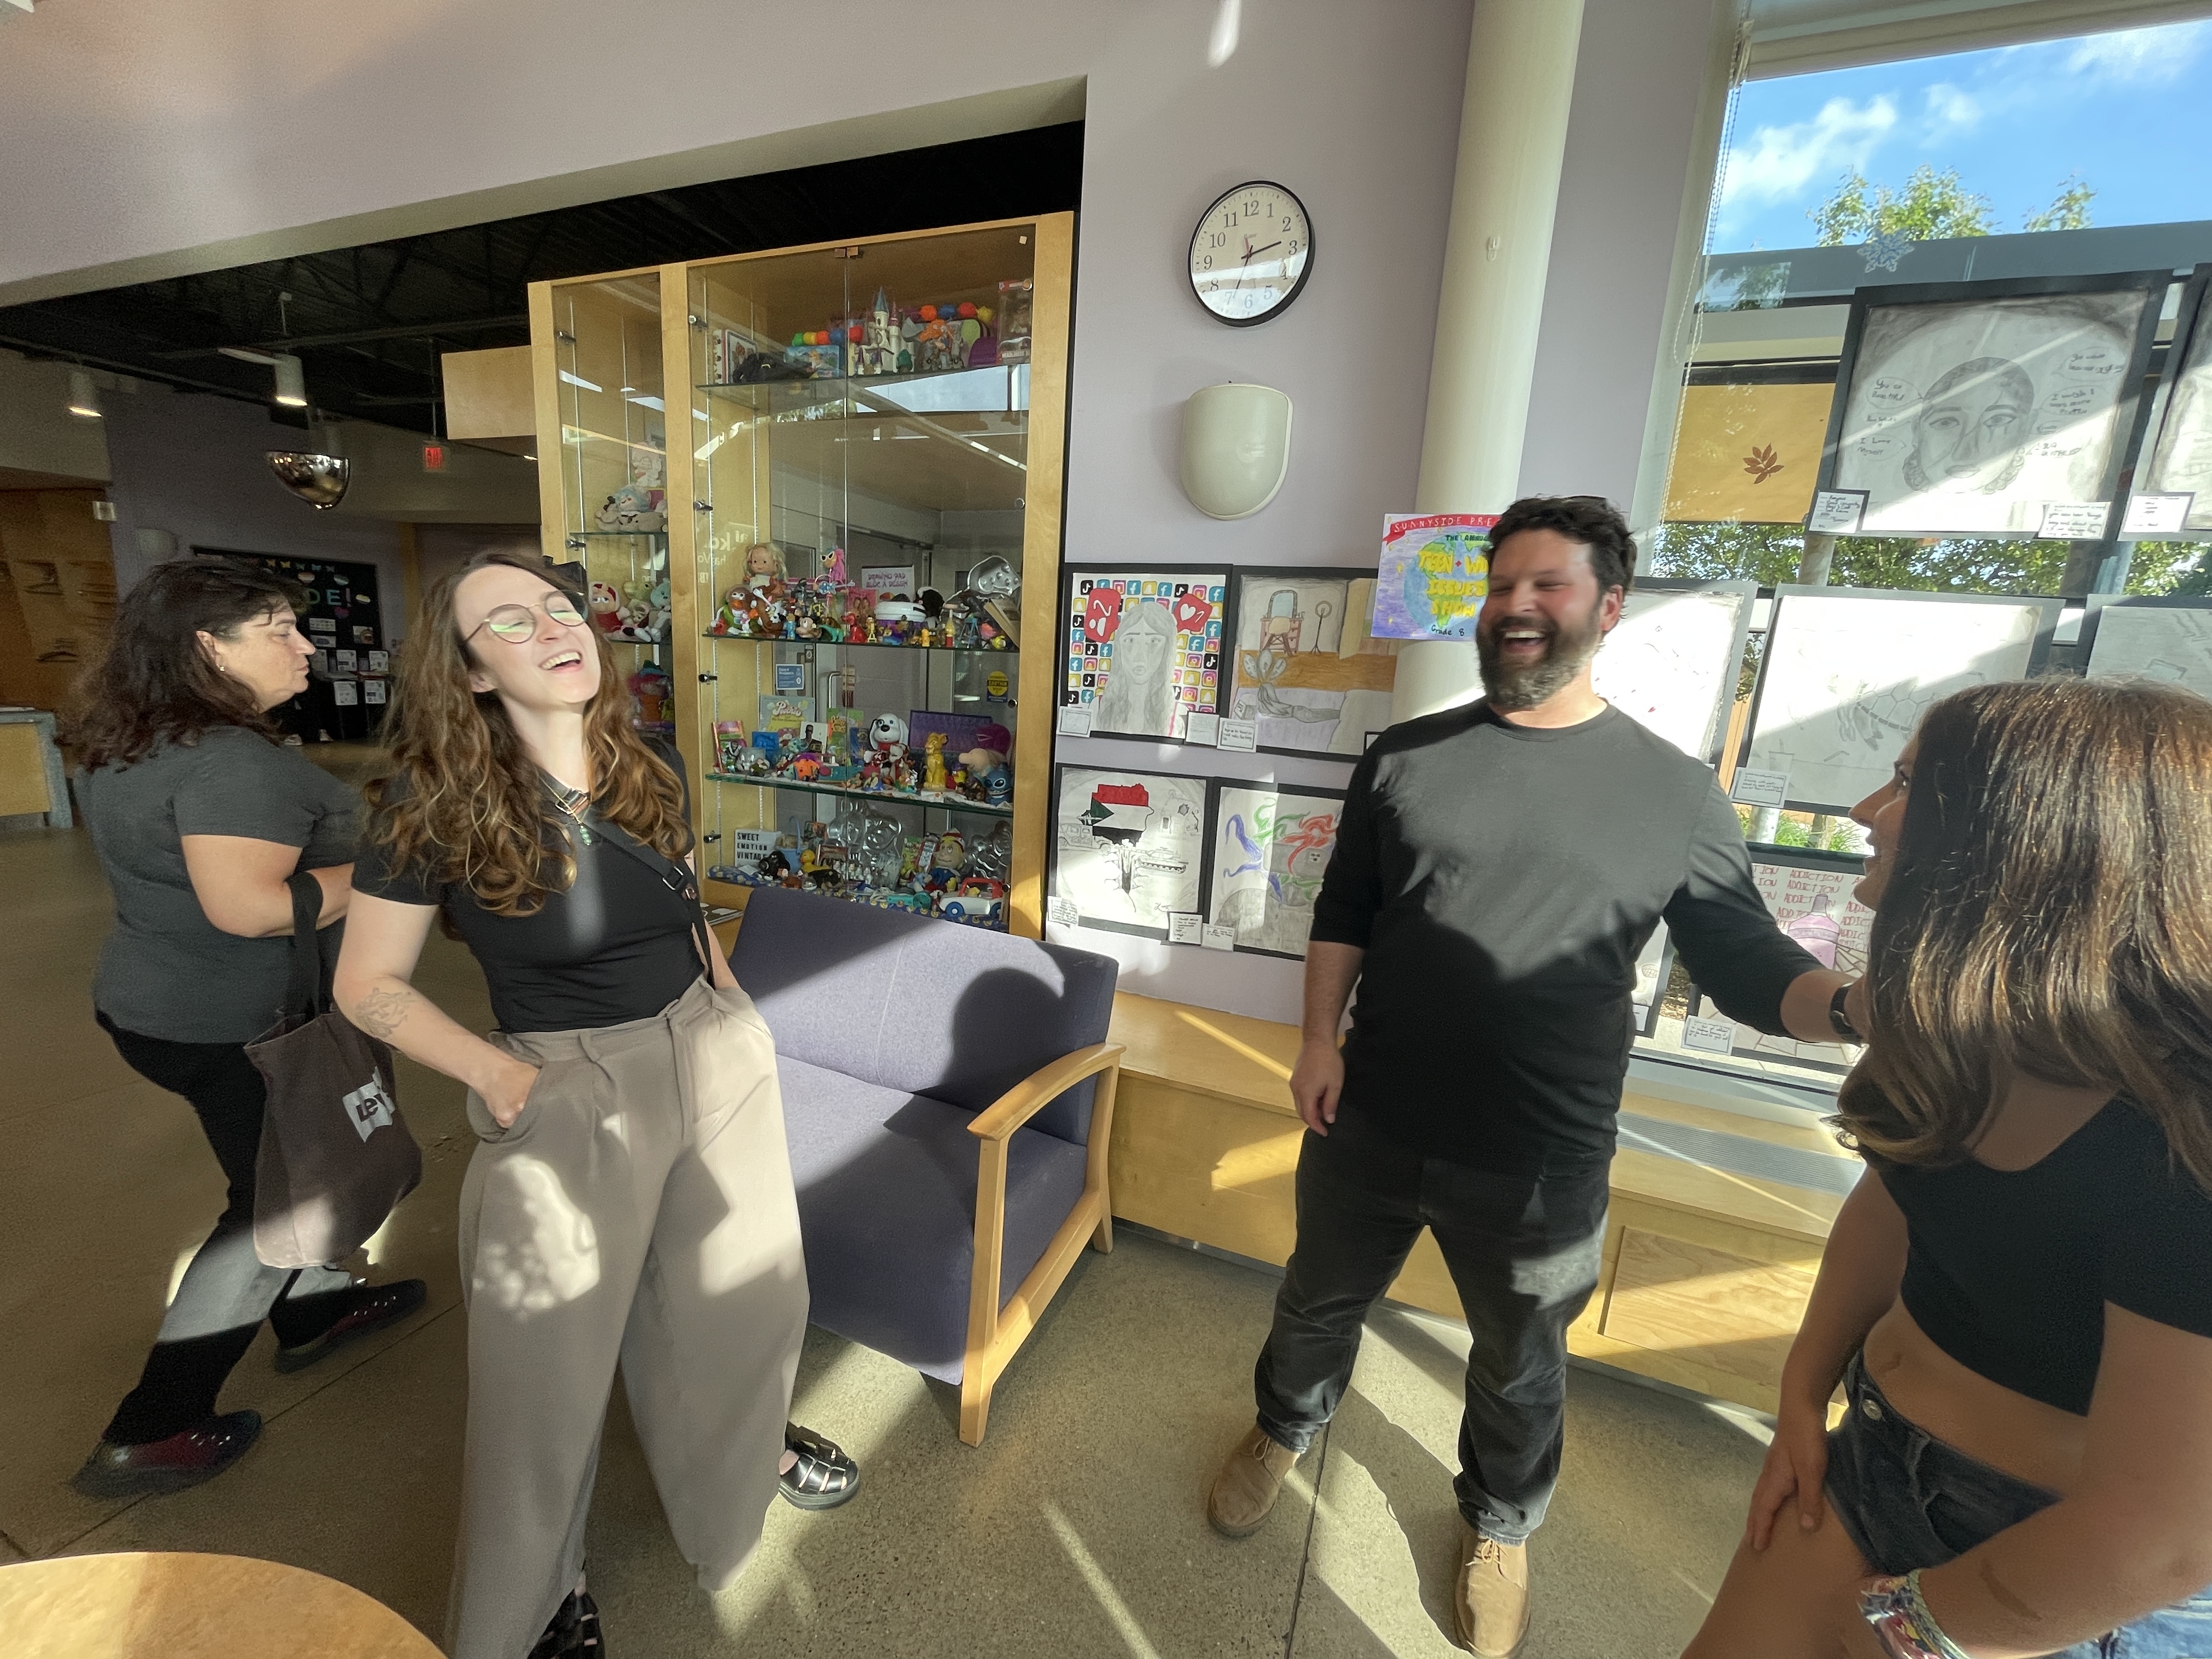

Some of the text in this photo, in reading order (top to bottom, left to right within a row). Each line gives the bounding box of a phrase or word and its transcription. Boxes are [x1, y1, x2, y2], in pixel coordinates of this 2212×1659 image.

[1243, 200, 1259, 217] 12
[1267, 203, 1274, 218] 1
[1223, 211, 1238, 228] 11
[1282, 216, 1291, 232] 2
[1209, 232, 1226, 248] 10
[1289, 240, 1297, 255] 3
[1204, 255, 1212, 269] 9
[1280, 266, 1288, 280] 4
[1210, 278, 1218, 292] 8
[1224, 291, 1232, 305] 7
[1264, 285, 1272, 300] 5
[1244, 294, 1253, 308] 6
[1431, 624, 1465, 636] Grade 8
[737, 832, 759, 841] SWEET
[1790, 869, 1844, 883] ADDICTION
[1787, 879, 1840, 893] ADDICTION
